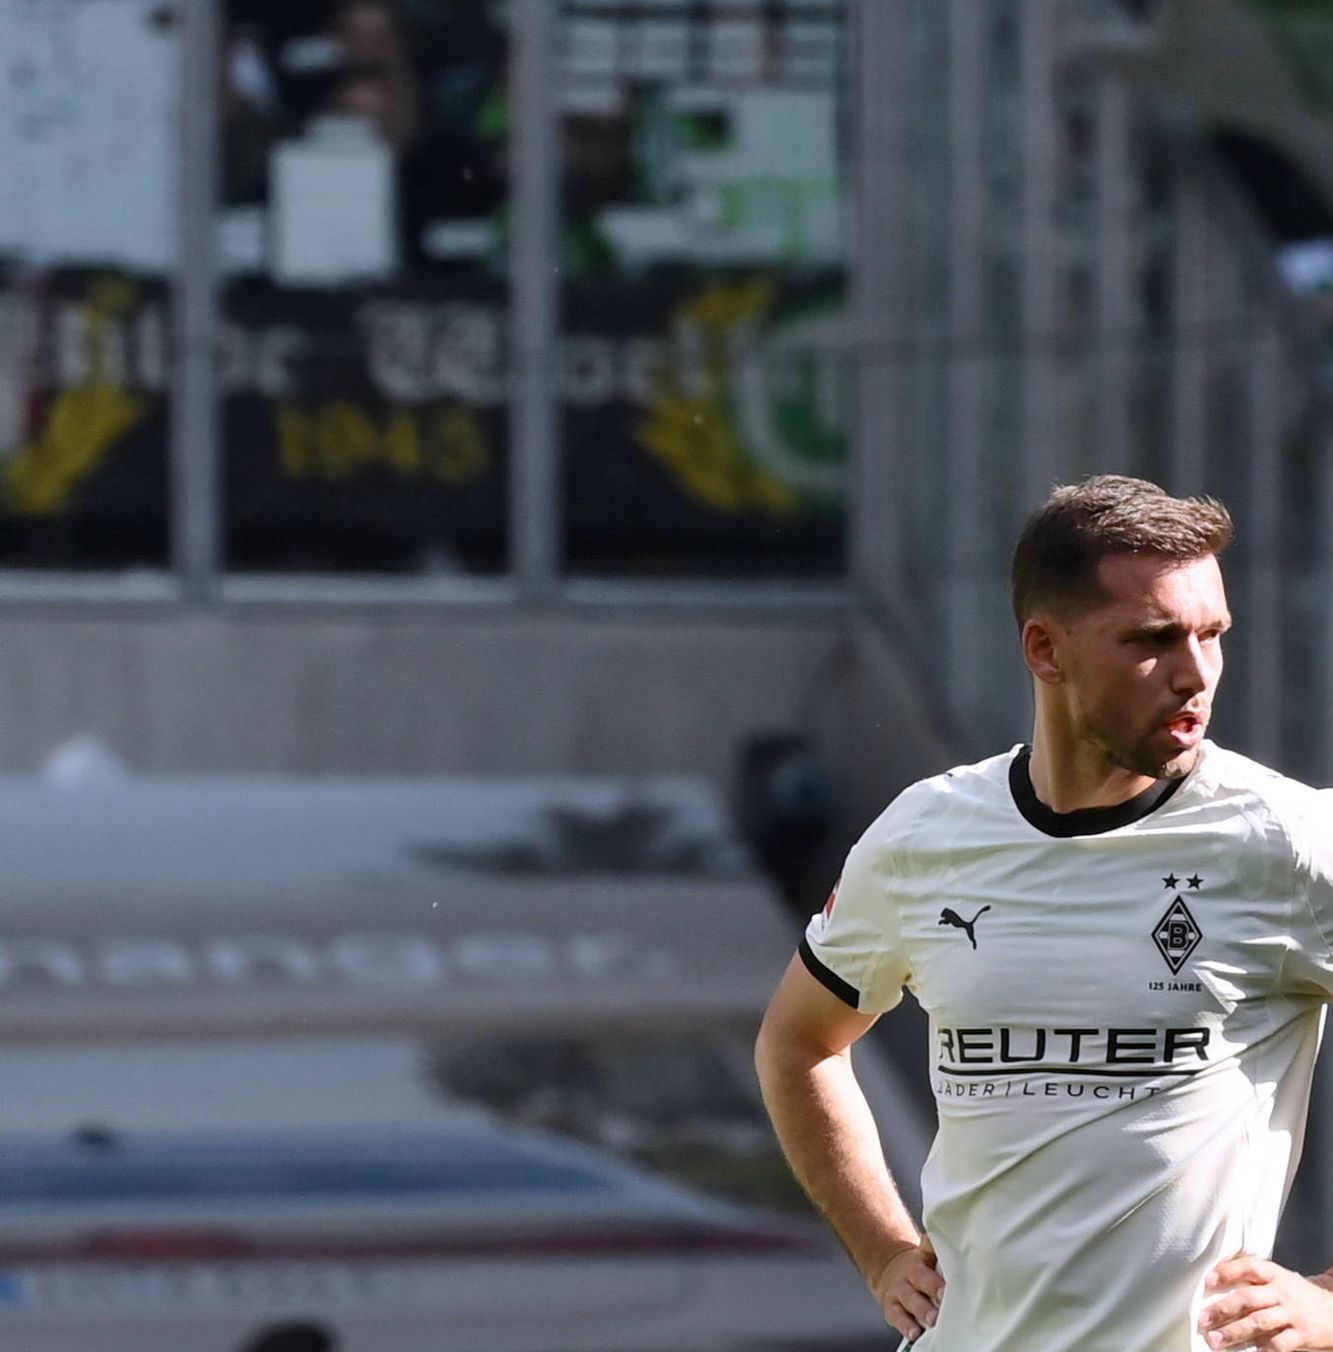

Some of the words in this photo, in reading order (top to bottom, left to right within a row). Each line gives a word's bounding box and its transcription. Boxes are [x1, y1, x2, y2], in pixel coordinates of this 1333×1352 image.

[1148, 982, 1164, 991] 125
[1167, 982, 1202, 992] JAHRE
[938, 1027, 1211, 1064] REUTER
